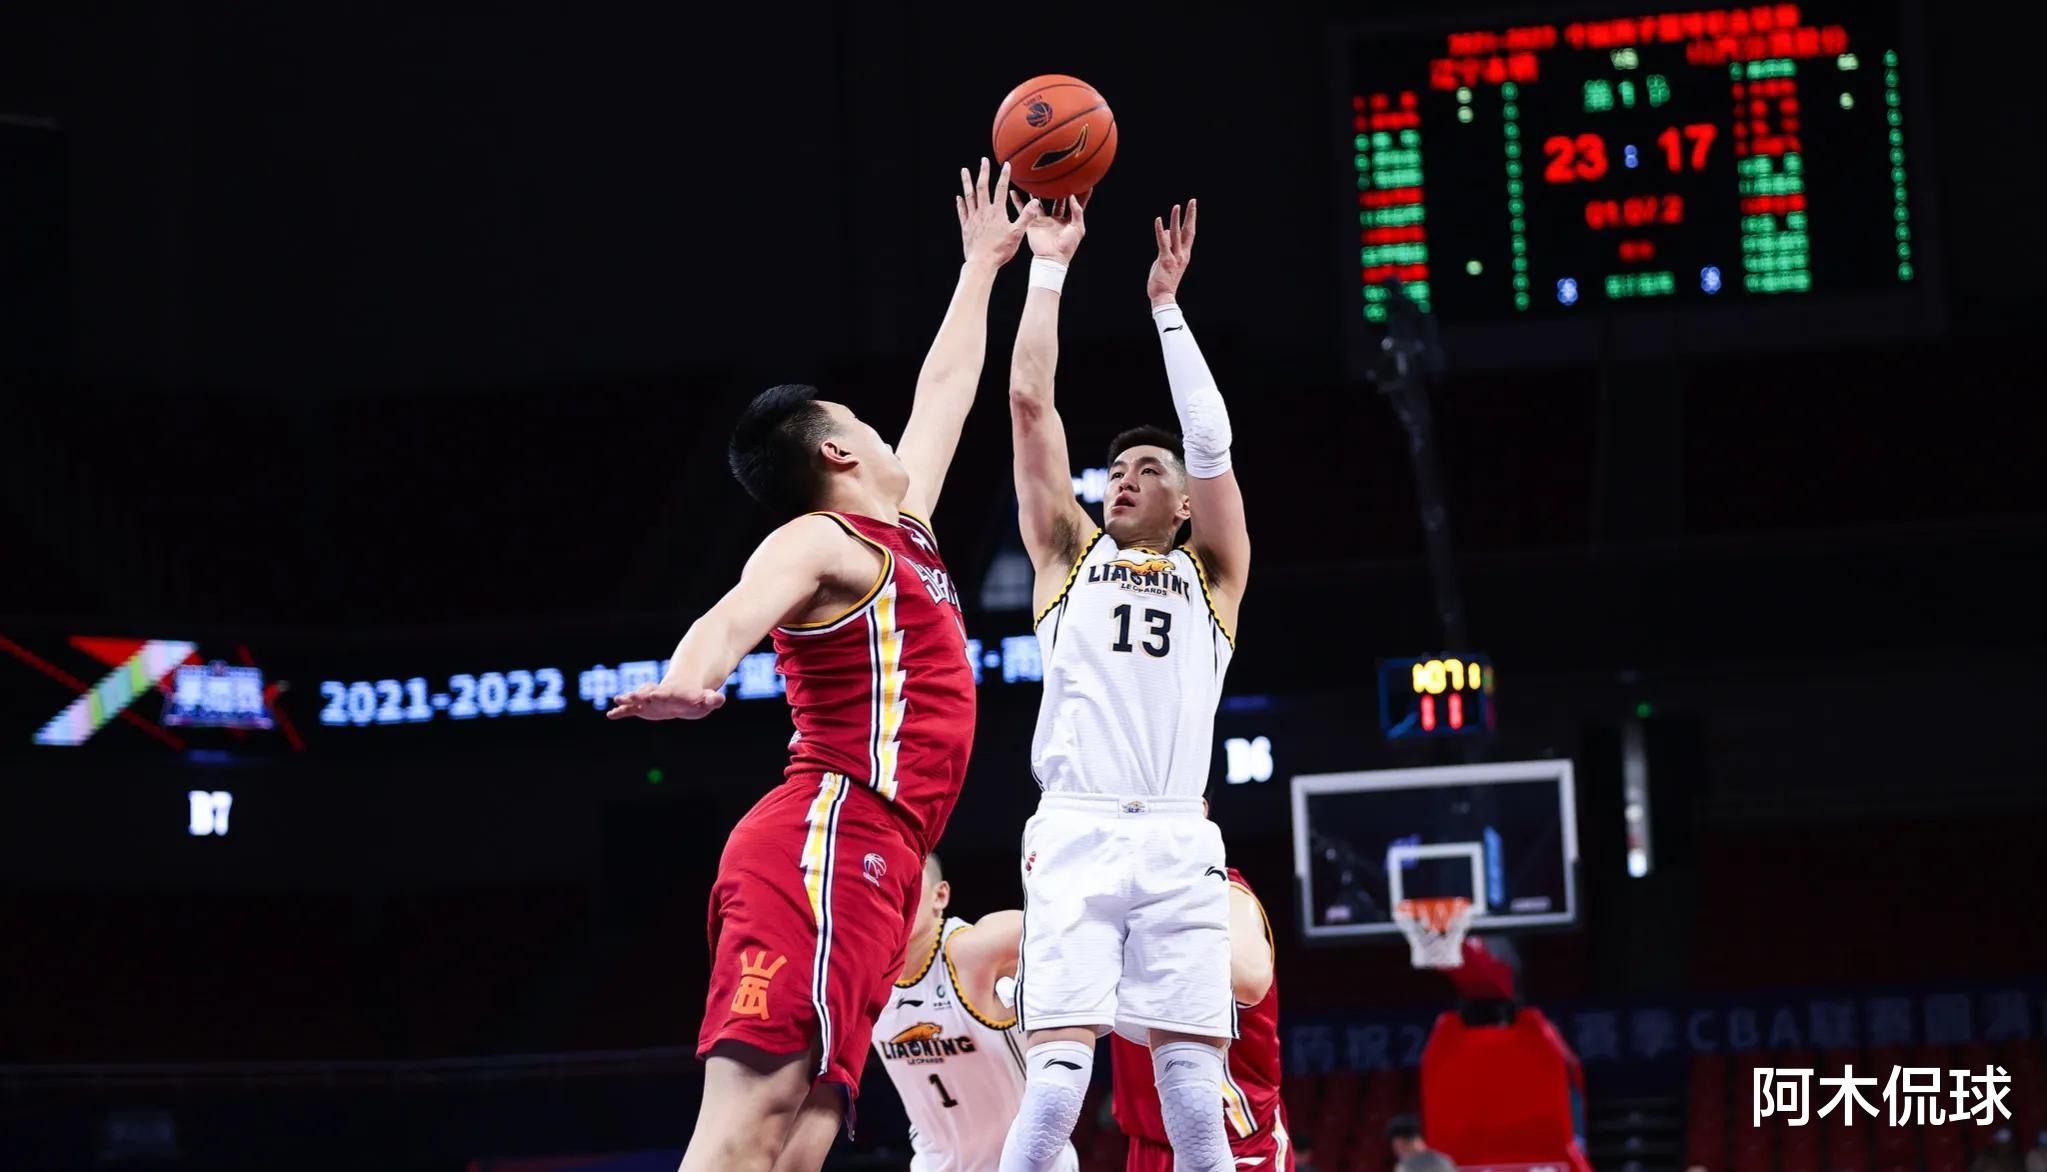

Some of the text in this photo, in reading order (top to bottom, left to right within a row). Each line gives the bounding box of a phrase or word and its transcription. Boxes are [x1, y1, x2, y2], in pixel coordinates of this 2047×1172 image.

[1544, 132, 1608, 183] 23
[1658, 123, 1717, 172] 17
[1111, 603, 1172, 658] 13
[320, 668, 566, 726] 2021-2022
[880, 1036, 977, 1060] LIAONING
[928, 1073, 958, 1108] 1
